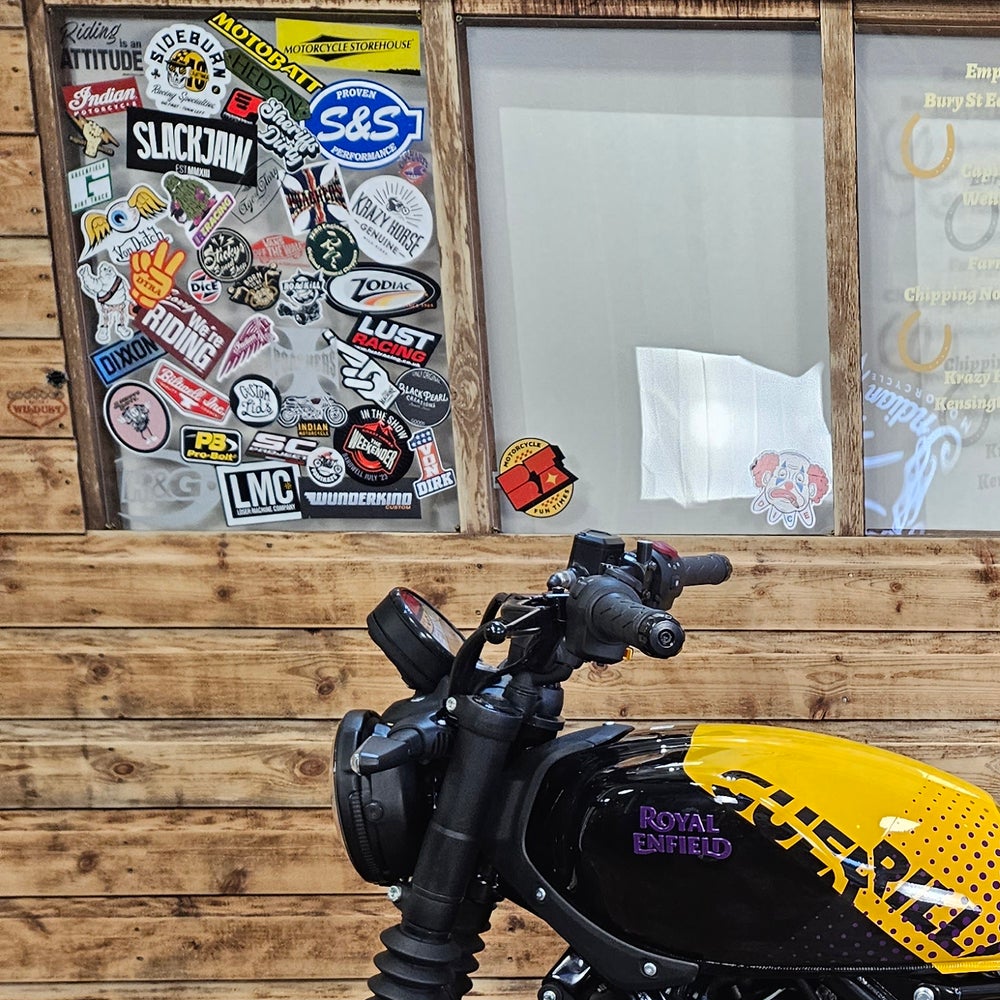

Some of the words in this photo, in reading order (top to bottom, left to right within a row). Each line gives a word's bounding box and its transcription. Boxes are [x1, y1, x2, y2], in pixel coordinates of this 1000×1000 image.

[60, 21, 121, 45] Riding
[284, 42, 349, 54] MOTORCYCLE
[350, 39, 412, 51] STOREHOUSE
[60, 49, 144, 71] ATTITUDE
[150, 29, 226, 78] SIDEBURN
[213, 11, 323, 93] MOTOBATT
[68, 85, 137, 110] Indian
[233, 54, 301, 115] HEDON
[336, 88, 378, 100] PROVEN
[73, 102, 138, 116] MOTORCYCLE
[923, 92, 963, 112] Bury
[965, 92, 983, 108] St
[317, 105, 402, 142] S&S
[132, 121, 253, 175] SLACKJAW
[330, 143, 398, 162] PERFORMANCE
[351, 191, 391, 229] KRAZY
[386, 221, 425, 257] HORSE
[132, 226, 166, 254] Dutch
[359, 223, 400, 255] GENUINE
[350, 278, 412, 303] ZODIAC
[904, 287, 977, 306] Chipping
[141, 303, 218, 370] RIDING
[357, 316, 436, 349] LUST
[100, 336, 160, 376] DIXXON
[352, 334, 428, 363] RACING
[943, 370, 990, 388] Krazy
[298, 422, 329, 431] INDIAN
[360, 409, 370, 420] IN
[371, 408, 388, 422] THE
[387, 415, 409, 439] SHOW
[195, 431, 227, 452] PB
[251, 432, 317, 455] SC
[347, 428, 398, 470] WEEKENDER
[503, 441, 542, 468] MOTORCYCLE
[229, 469, 295, 508] LMC
[304, 491, 413, 506] WUNDERKIND
[416, 473, 455, 497] DIRK
[552, 489, 570, 510] TIMES
[639, 805, 720, 835] ROYAL
[632, 832, 733, 861] ENFIELD
